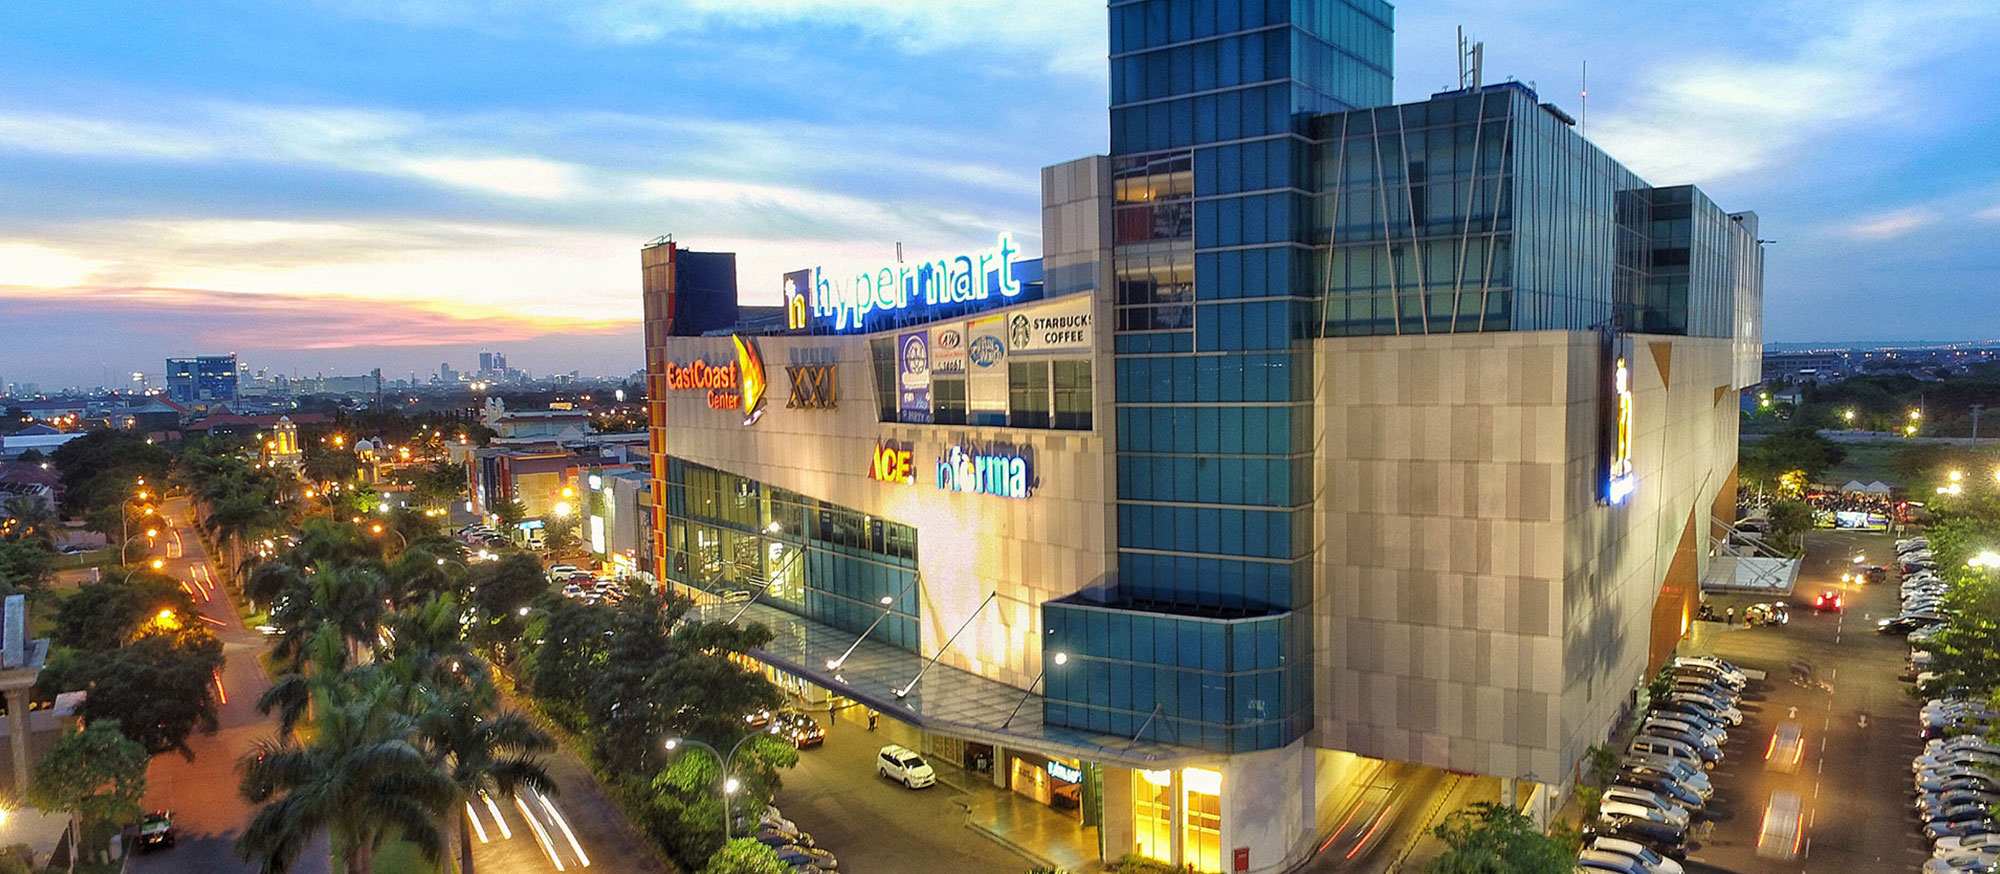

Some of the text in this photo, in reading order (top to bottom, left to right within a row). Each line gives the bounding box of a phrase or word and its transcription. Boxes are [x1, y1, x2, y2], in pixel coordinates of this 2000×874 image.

[815, 233, 1020, 330] hypermart
[1044, 330, 1084, 344] COFFEE
[667, 359, 738, 390] EastCoast
[785, 365, 838, 409] XXI
[707, 390, 738, 410] Center
[868, 443, 913, 485] ACE
[935, 445, 1027, 499] informa
